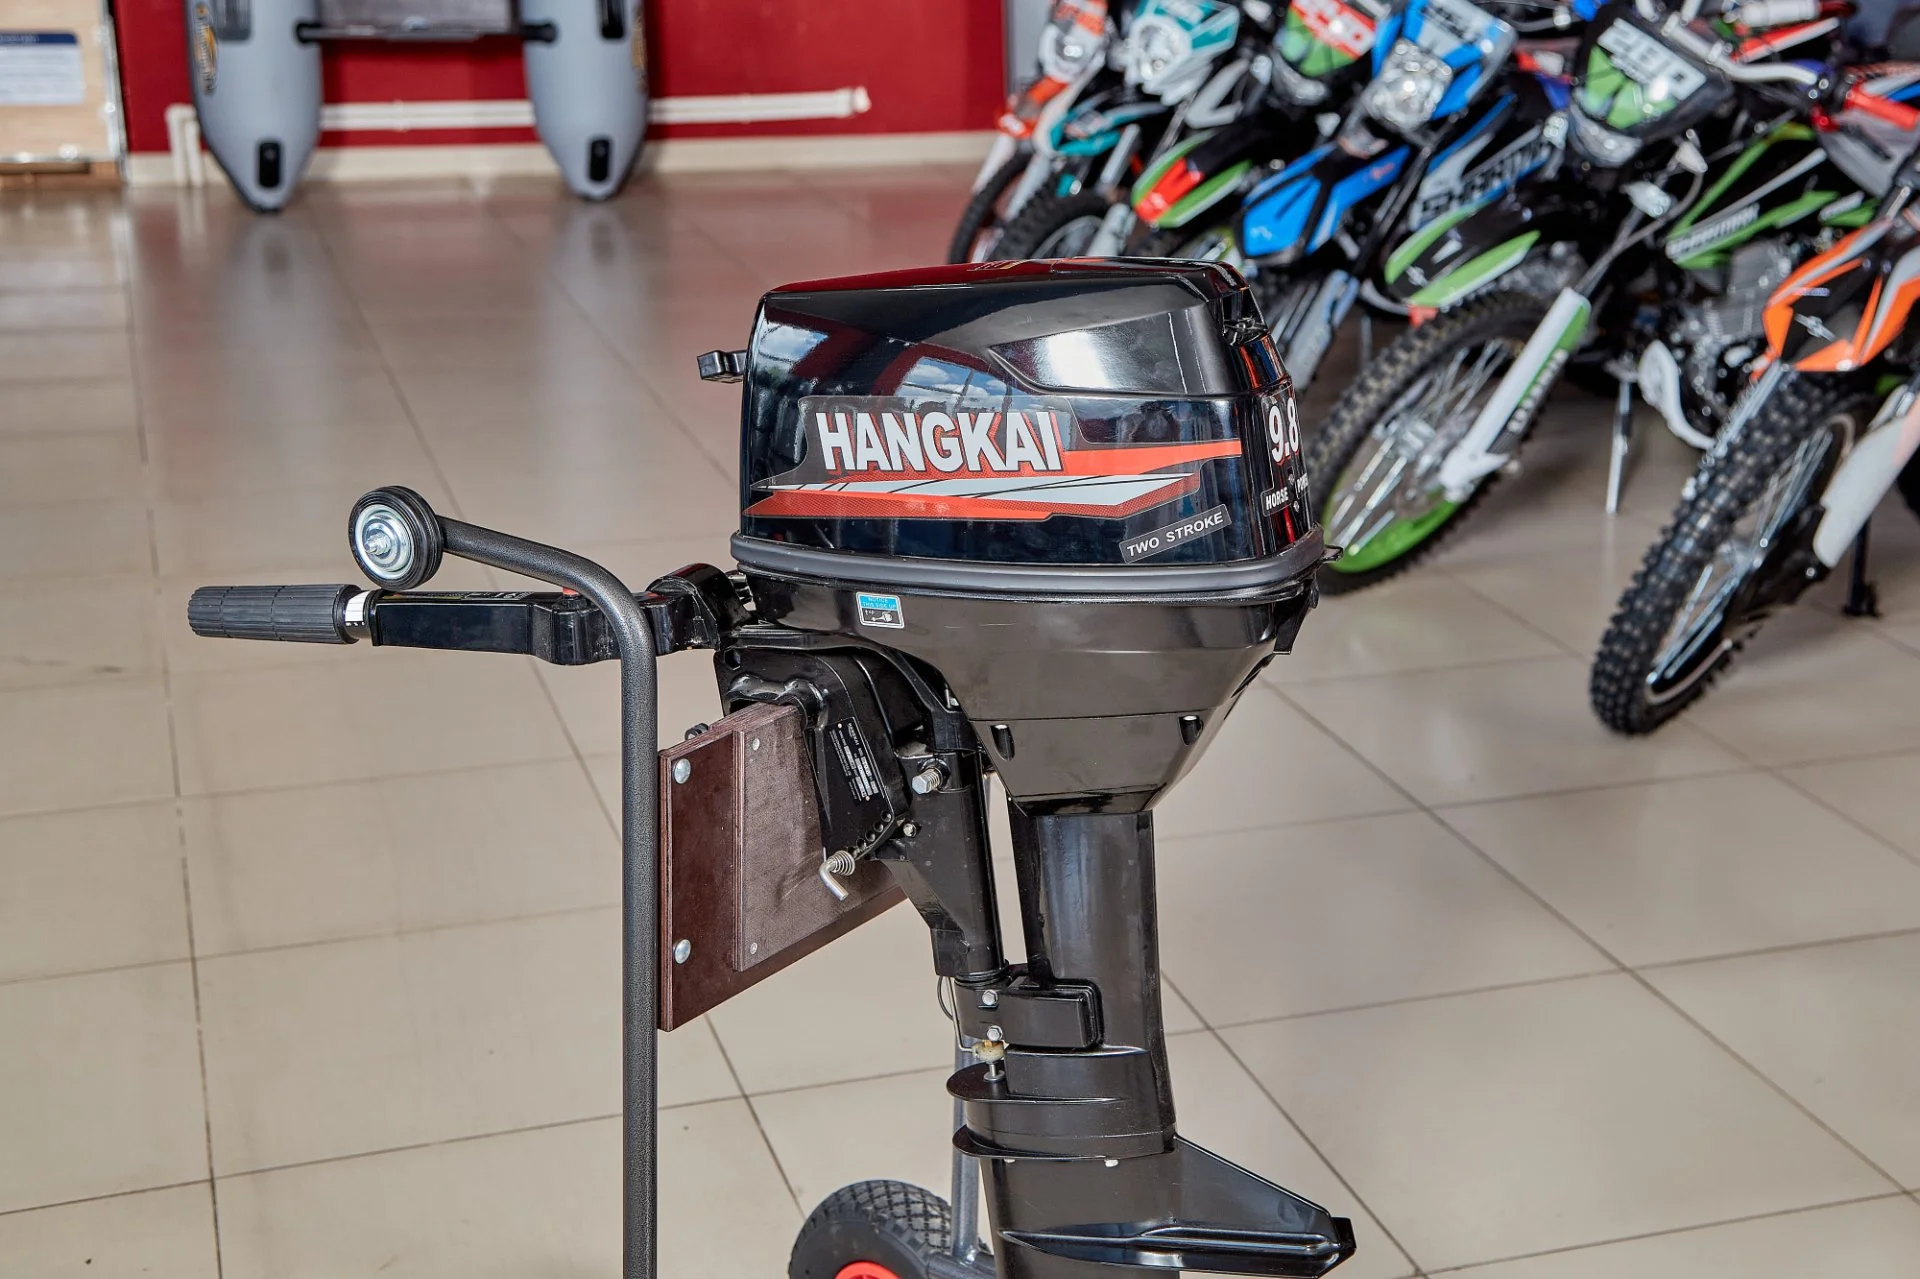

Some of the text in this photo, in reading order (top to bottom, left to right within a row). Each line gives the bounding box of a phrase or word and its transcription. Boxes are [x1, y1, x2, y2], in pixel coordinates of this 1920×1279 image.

[815, 411, 1064, 473] HANGKAI
[1268, 397, 1299, 463] 9.8
[1265, 487, 1289, 511] HORSE
[1126, 511, 1224, 557] TWO STROKE
